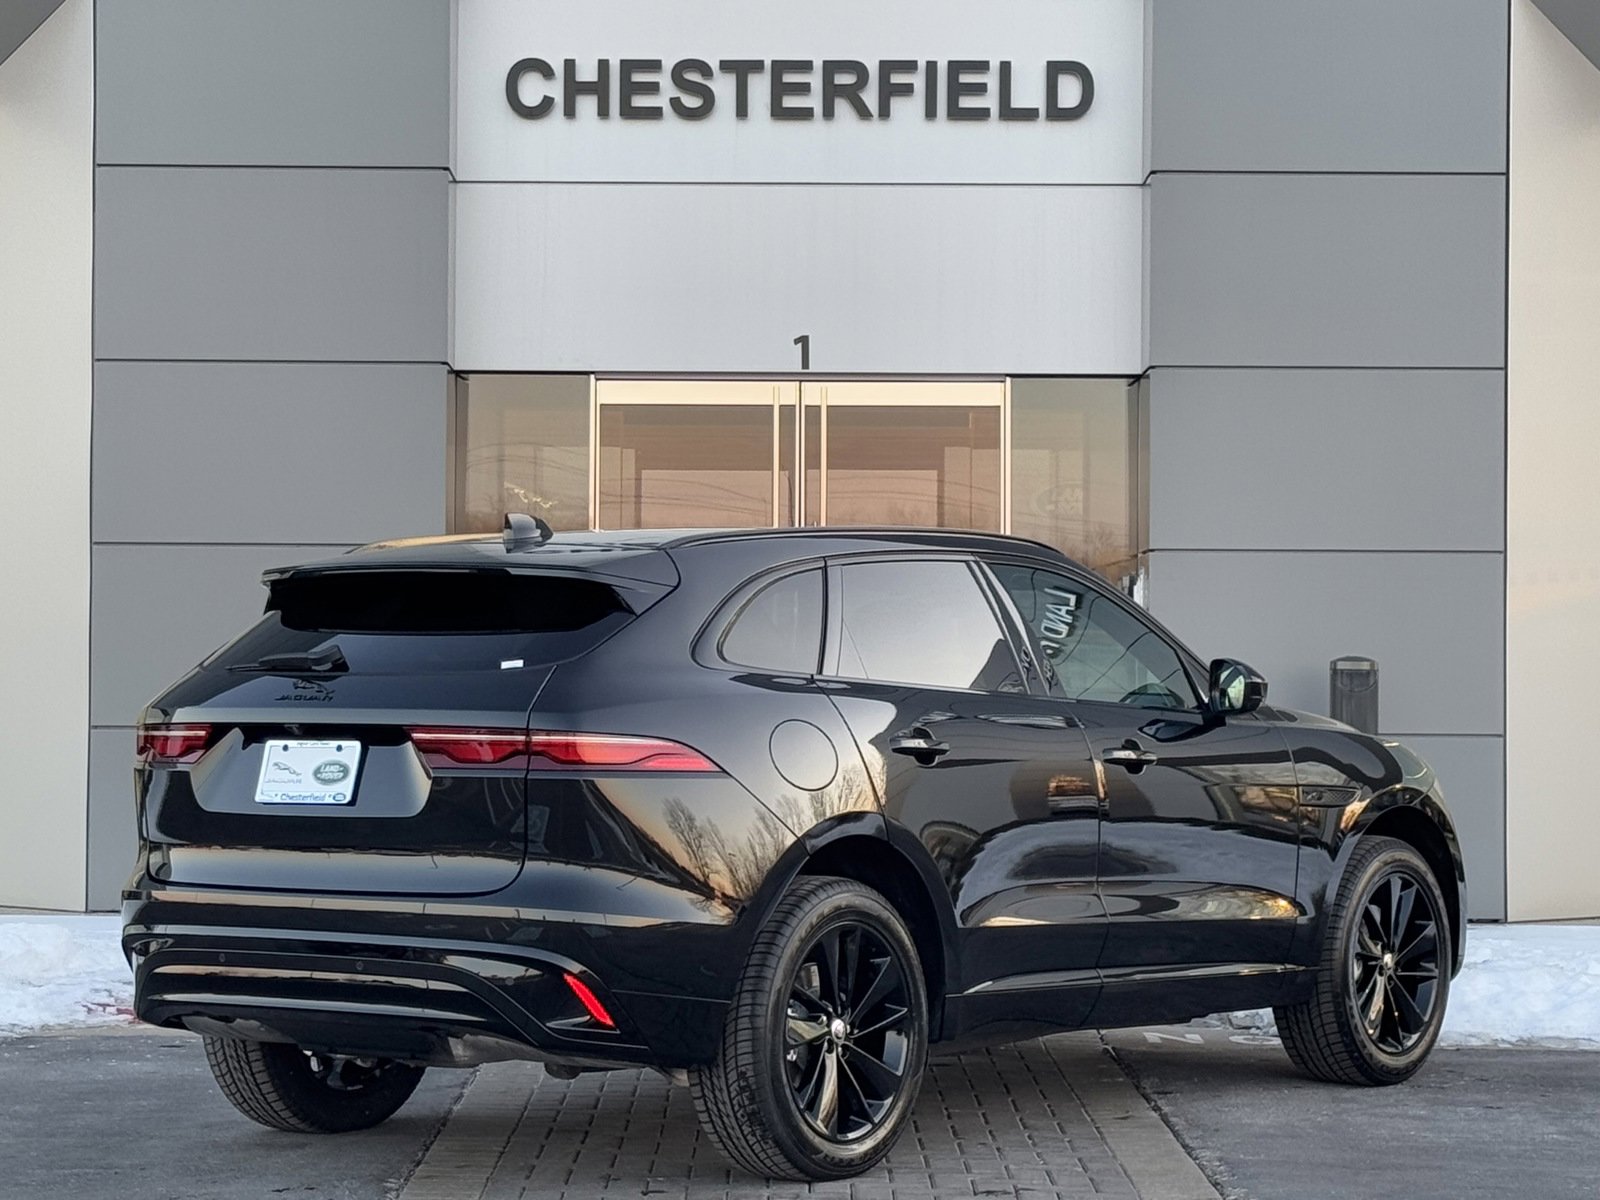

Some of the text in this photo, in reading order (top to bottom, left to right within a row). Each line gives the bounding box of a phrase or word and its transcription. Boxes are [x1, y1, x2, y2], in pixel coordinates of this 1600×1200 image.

[505, 57, 1095, 121] CHESTERFIELD
[793, 334, 810, 370] 1
[280, 793, 325, 802] Chesterfield
